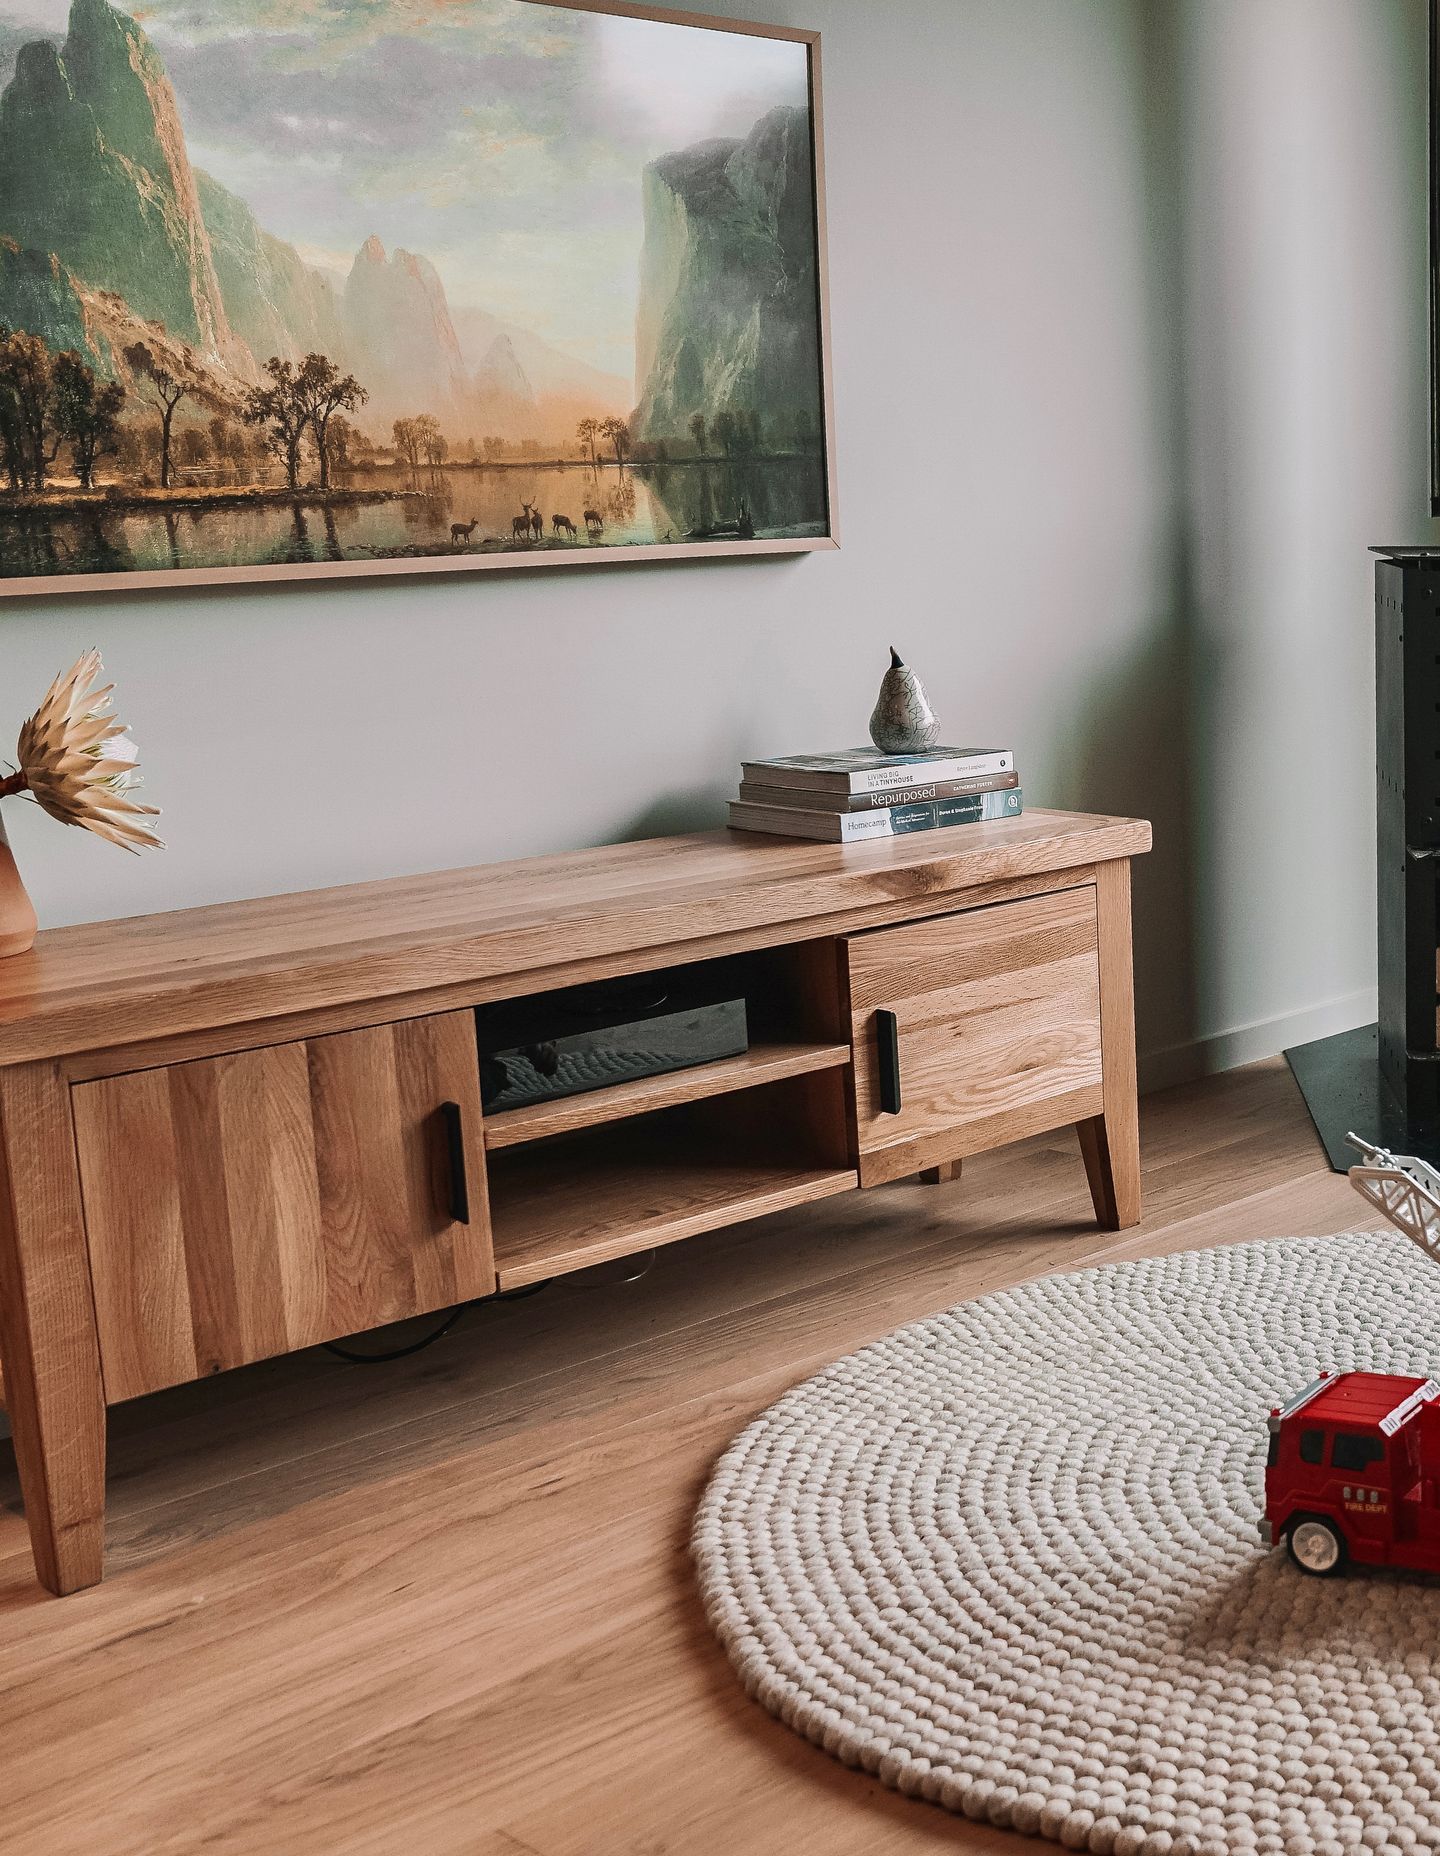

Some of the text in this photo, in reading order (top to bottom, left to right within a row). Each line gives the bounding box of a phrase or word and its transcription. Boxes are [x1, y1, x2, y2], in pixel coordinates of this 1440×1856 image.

[870, 784, 936, 806] Repurposed
[847, 817, 887, 831] Homecamp
[1344, 1502, 1364, 1512] FIRE
